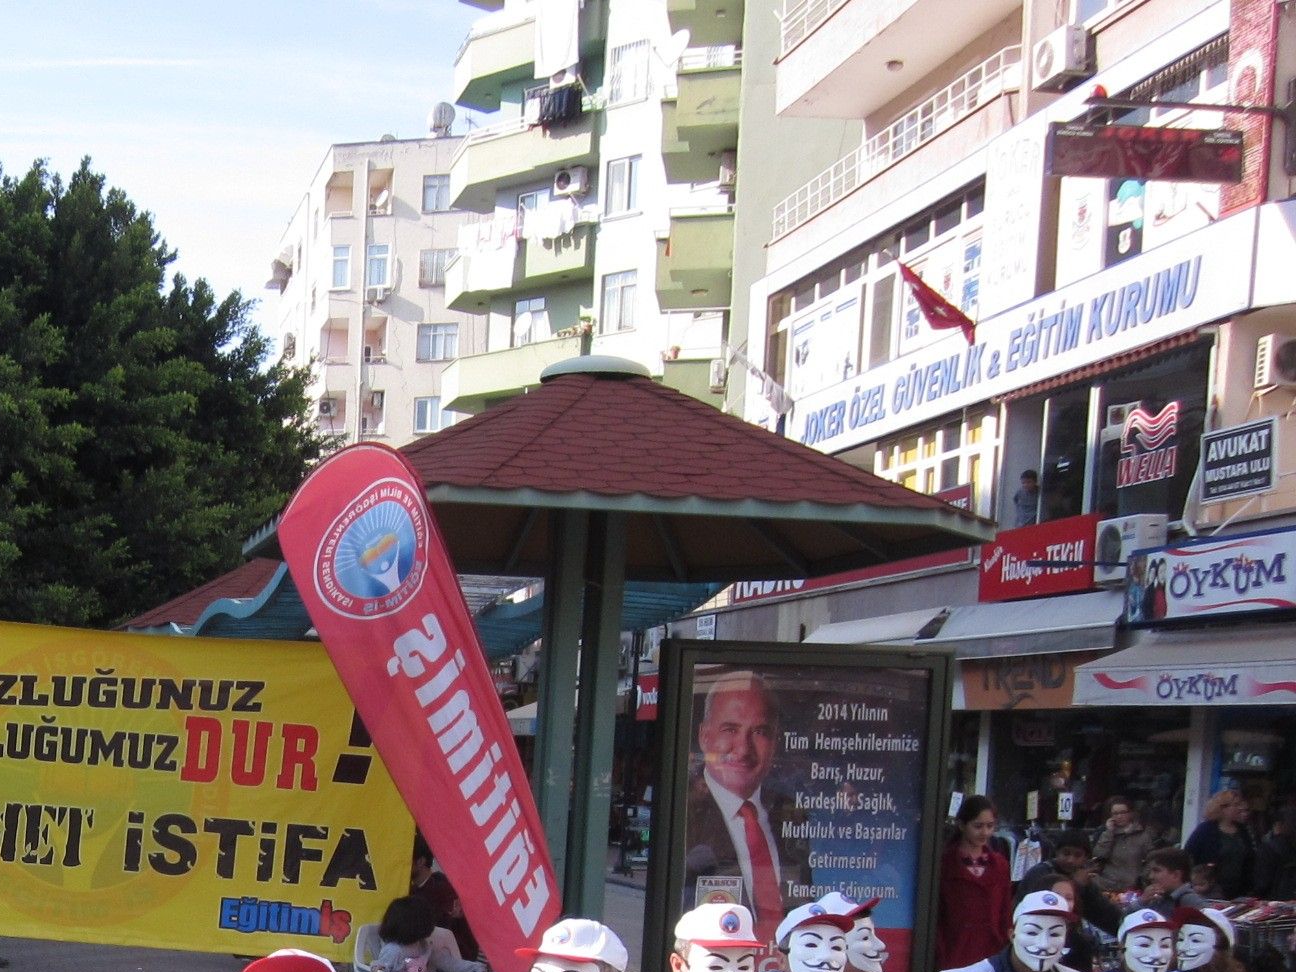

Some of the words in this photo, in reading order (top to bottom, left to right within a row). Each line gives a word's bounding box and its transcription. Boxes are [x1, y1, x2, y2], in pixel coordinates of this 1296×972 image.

[801, 399, 847, 446] JOKER
[848, 385, 886, 430] ÖZEL
[987, 350, 1001, 380] &
[1006, 299, 1085, 373] EĞİTİM
[1086, 254, 1203, 344] KURUMU
[1206, 428, 1270, 463] AVUKAT
[1116, 446, 1178, 489] WELLA
[1205, 462, 1249, 483] MUSTAFA
[1249, 456, 1270, 473] ULU
[1168, 552, 1288, 600] ÖYKÜM
[1156, 673, 1239, 701] ÖYKÜM
[817, 703, 848, 721] 2014
[850, 703, 889, 721] Yılının
[784, 731, 809, 750] Tüm
[815, 732, 920, 755] Hemşehrilerimize
[811, 762, 844, 783] Barış,
[846, 763, 885, 784] Huzur,
[795, 791, 855, 814] Kardeşlik,
[856, 793, 897, 814] Sağlık,
[782, 821, 836, 840] Mutluluk
[837, 825, 853, 839] ve
[855, 822, 908, 844] Başarılar
[808, 851, 878, 870] Getirmesini
[787, 880, 837, 899] Temenni
